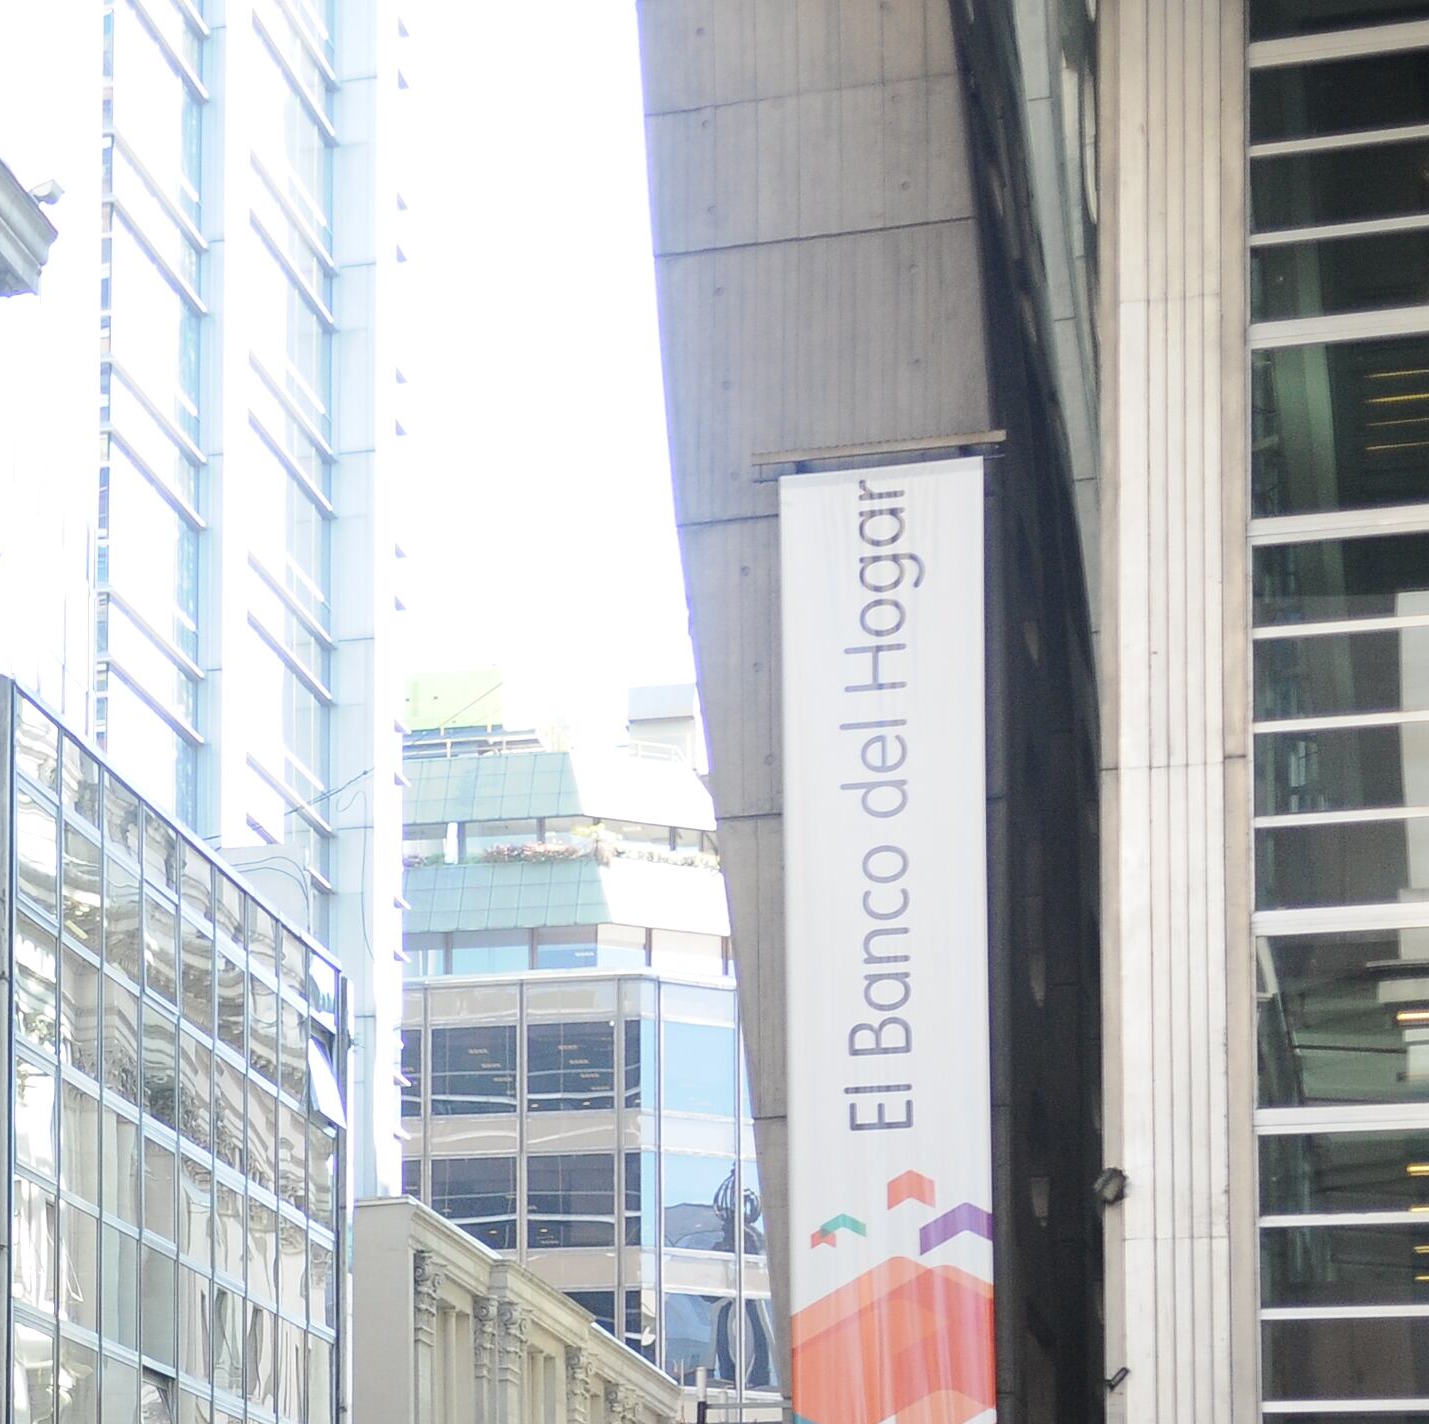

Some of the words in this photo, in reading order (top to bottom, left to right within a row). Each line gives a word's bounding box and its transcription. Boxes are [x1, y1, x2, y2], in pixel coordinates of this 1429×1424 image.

[844, 479, 926, 693] Hogar
[839, 718, 908, 818] del
[848, 844, 912, 1056] Banco
[844, 1083, 913, 1131] El
